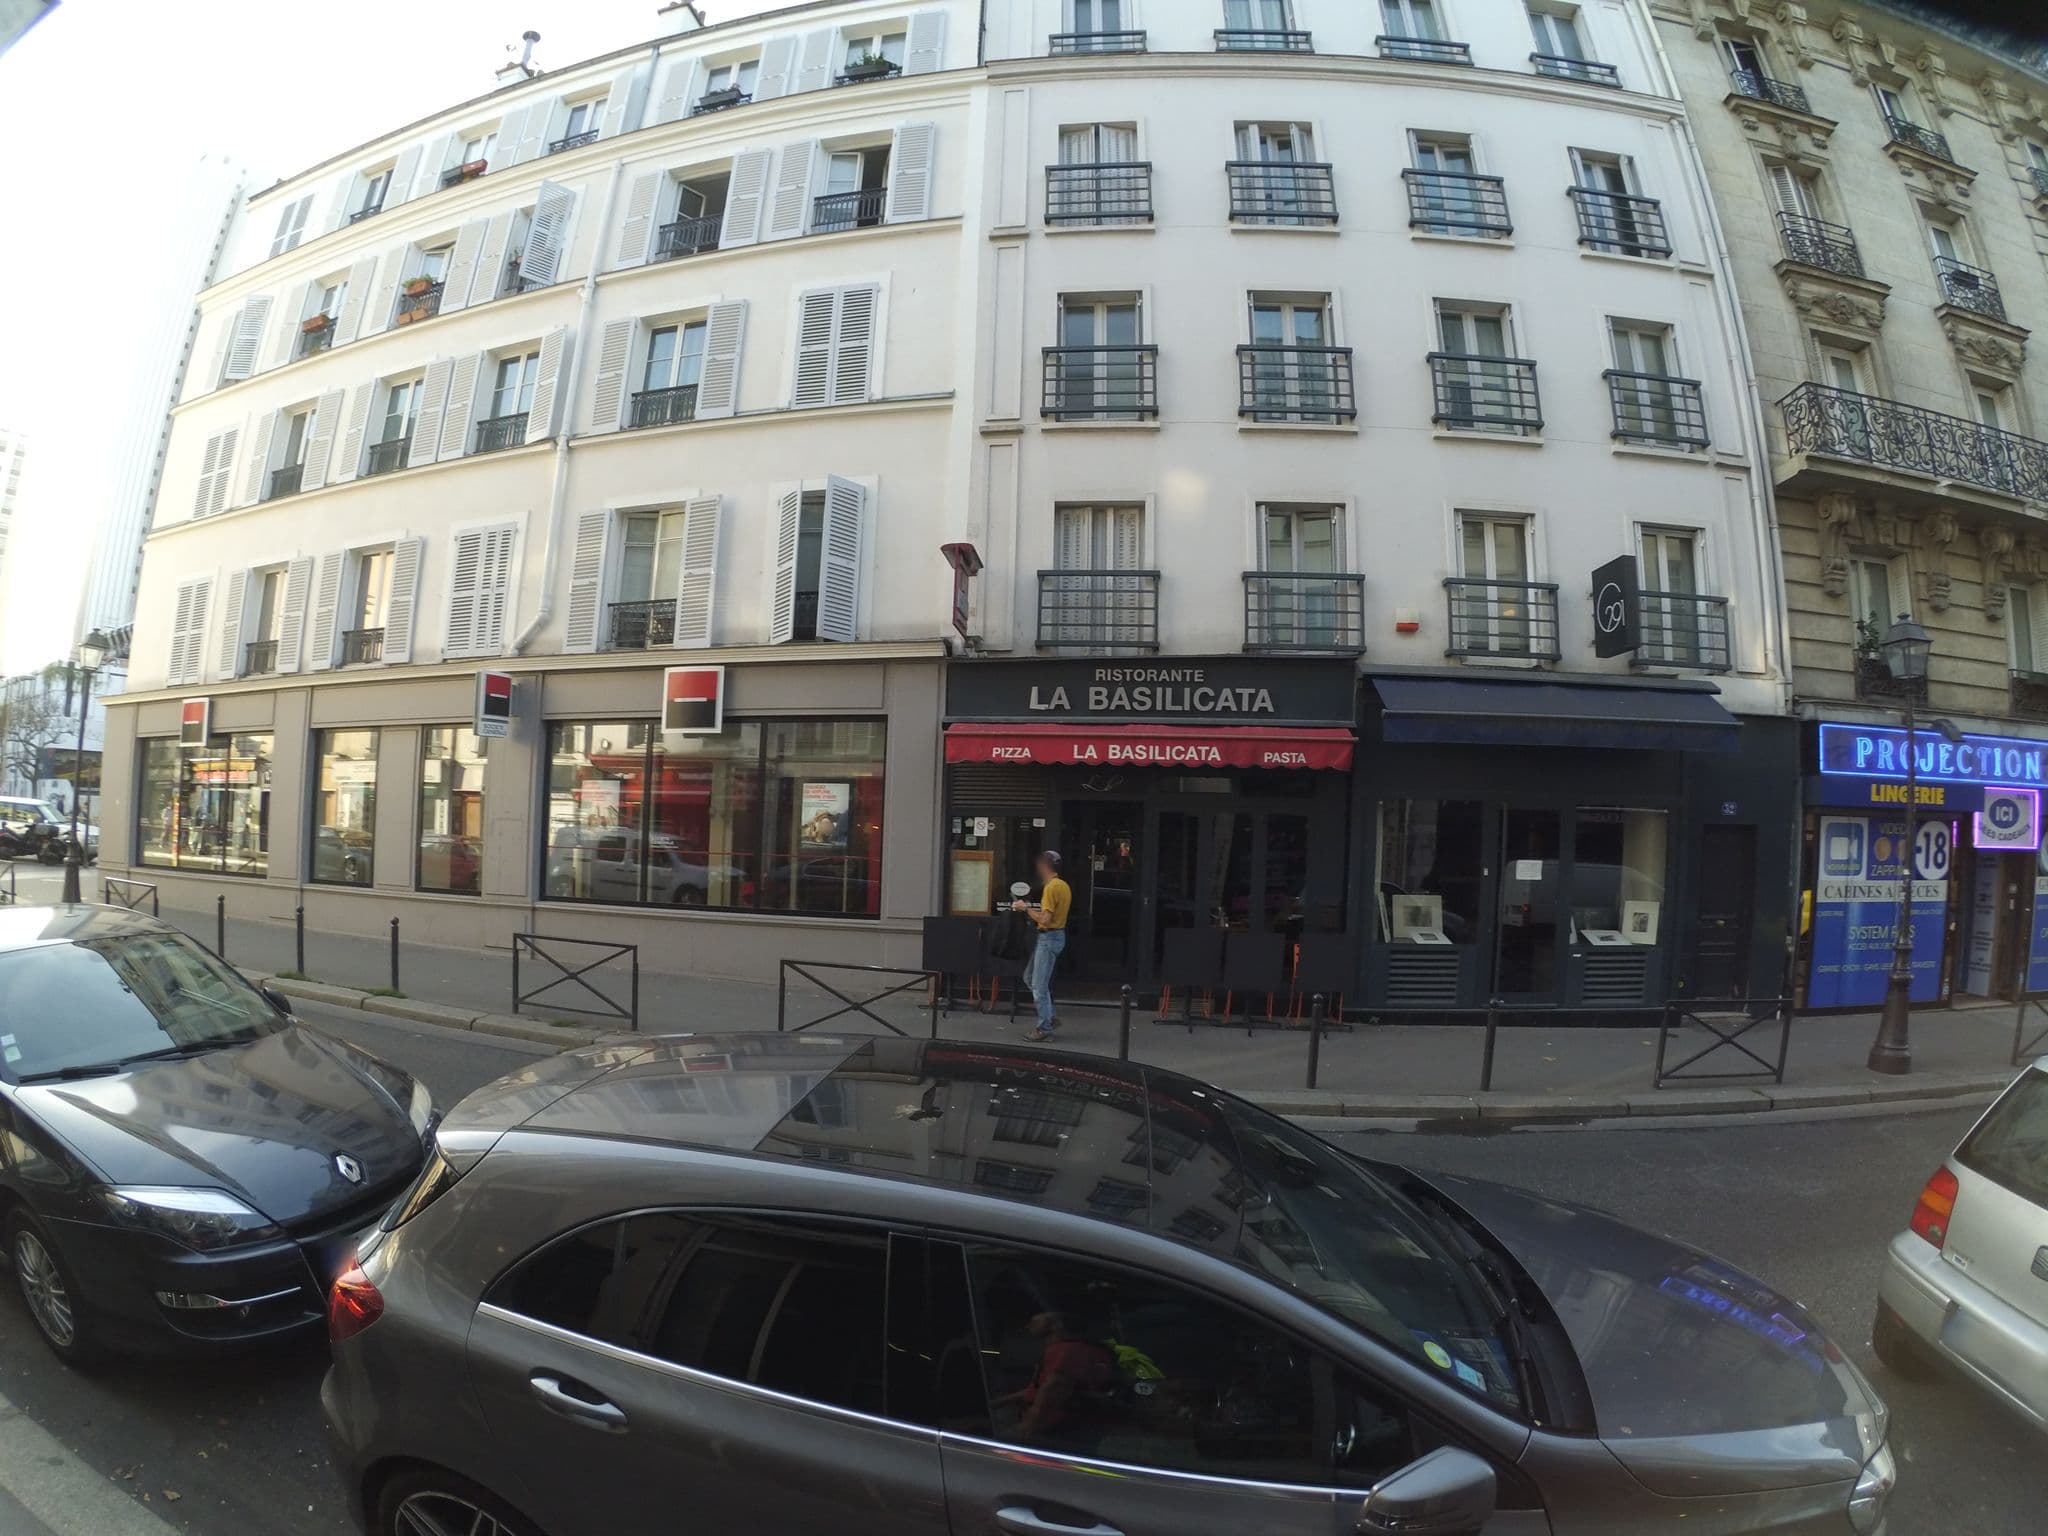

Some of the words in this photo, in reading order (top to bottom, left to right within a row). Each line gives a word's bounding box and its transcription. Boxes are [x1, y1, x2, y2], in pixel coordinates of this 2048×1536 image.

[1095, 669, 1204, 682] RISTORANTE
[1029, 686, 1071, 711] LA
[1088, 687, 1274, 713] BASILICATA
[992, 747, 1032, 759] PIZZA
[1073, 744, 1097, 760] LA
[1108, 745, 1221, 761] BASILICATA
[1263, 752, 1307, 764] PASTA
[1855, 737, 2041, 780] PROJECTION
[1995, 806, 2013, 821] ICI
[1848, 925, 1889, 940] SYSTEM
